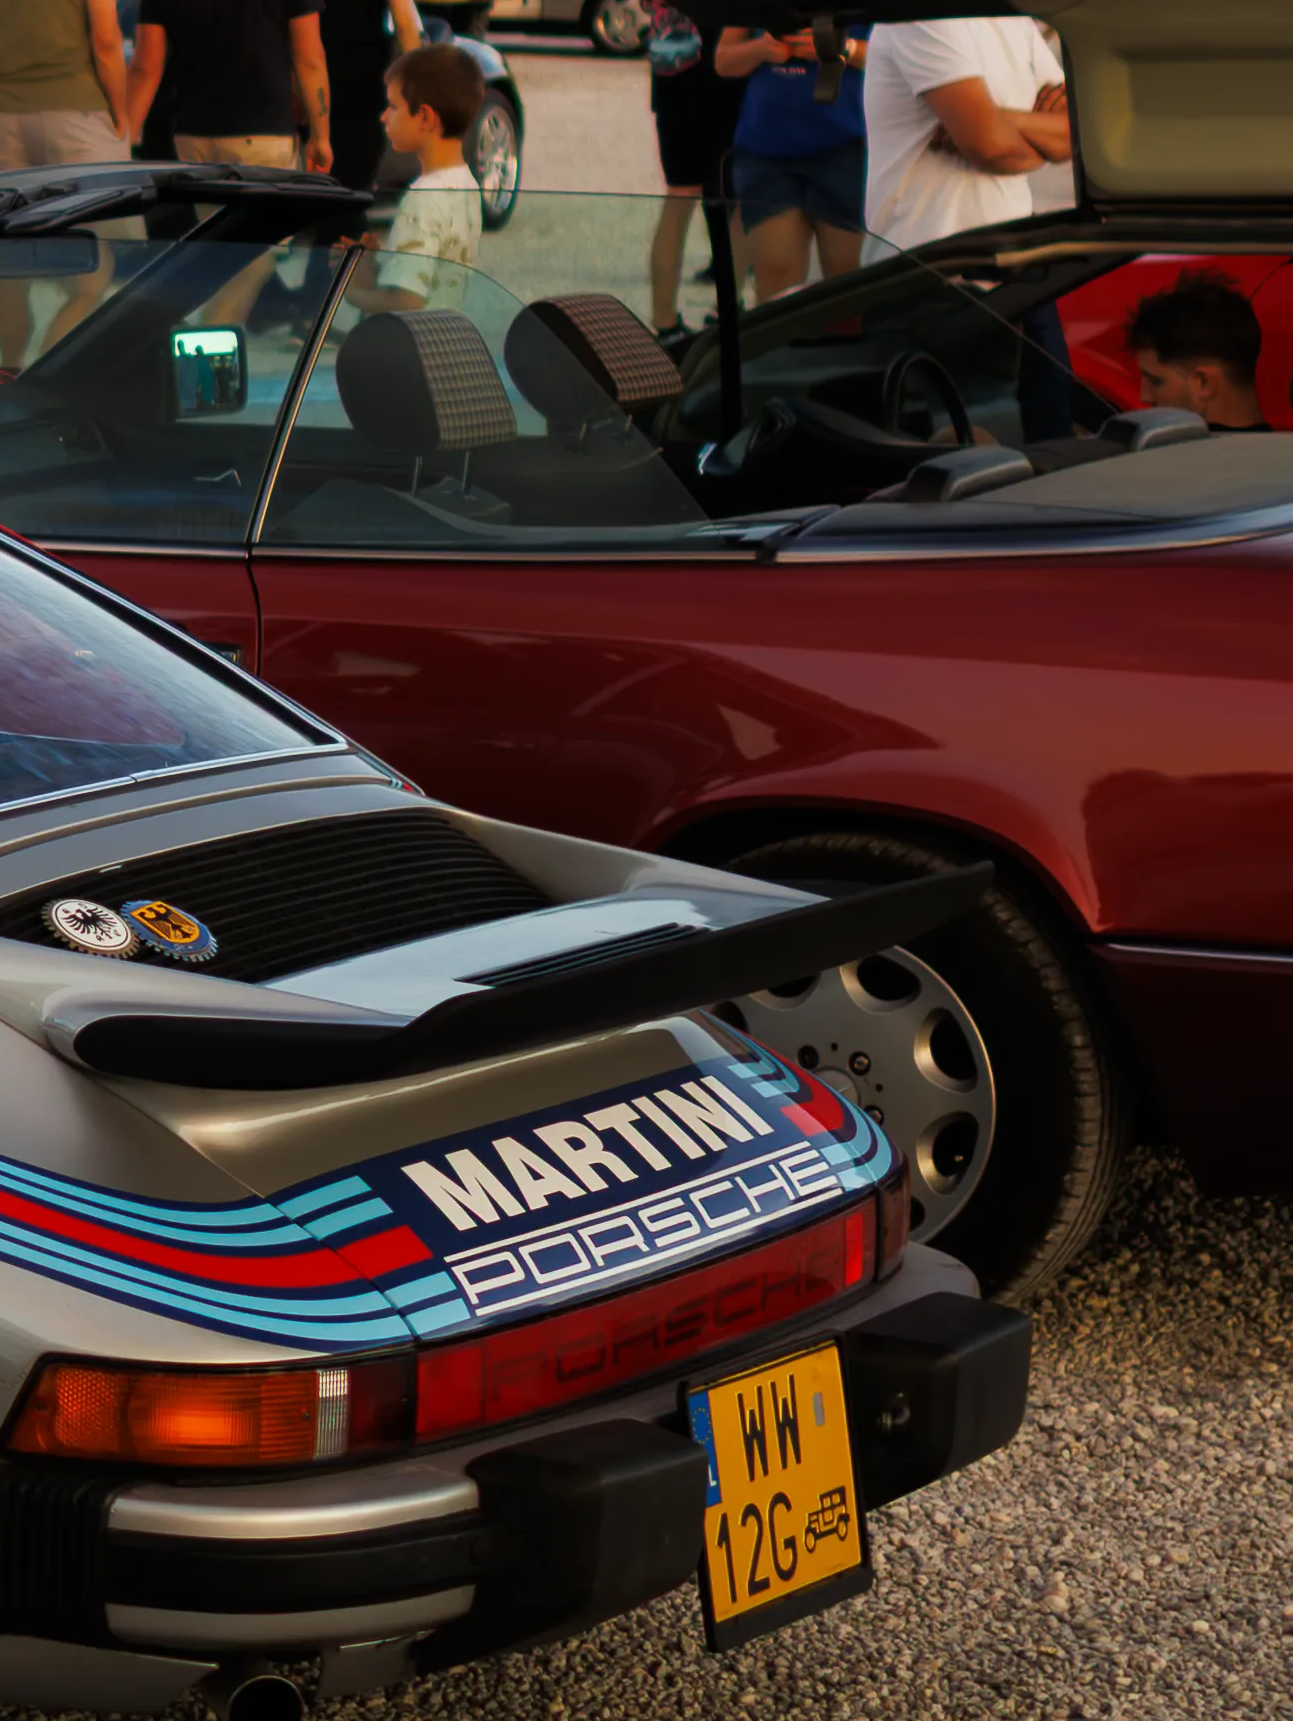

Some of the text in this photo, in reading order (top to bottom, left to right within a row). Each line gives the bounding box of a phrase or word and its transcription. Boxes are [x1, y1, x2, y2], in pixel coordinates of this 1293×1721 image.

[400, 1075, 775, 1232] MARTINI
[450, 1147, 837, 1306] PORSCHE
[735, 1373, 802, 1484] WW
[716, 1490, 799, 1606] 12G
